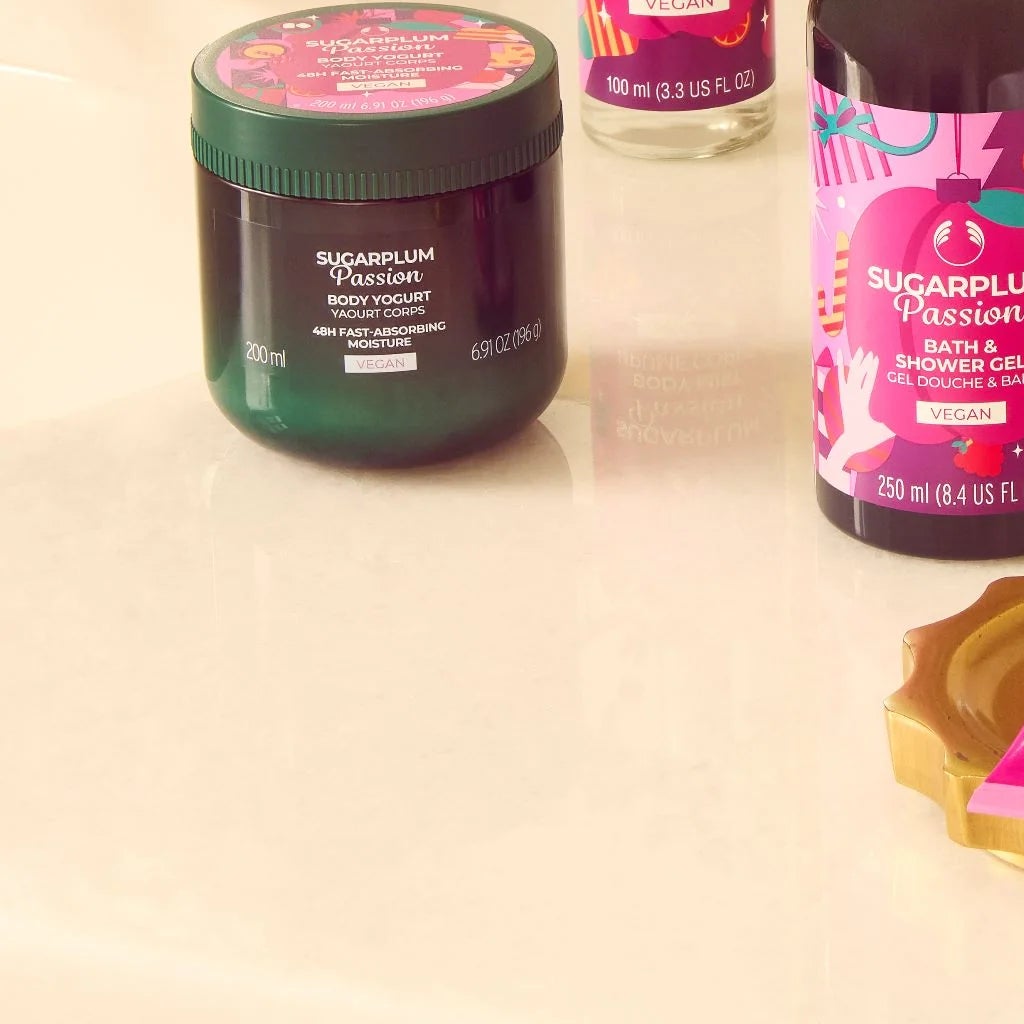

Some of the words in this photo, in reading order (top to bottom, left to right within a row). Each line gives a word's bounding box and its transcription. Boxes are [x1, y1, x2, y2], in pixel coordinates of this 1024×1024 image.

[306, 35, 449, 48] SUGARPLUM
[322, 42, 436, 54] Passion
[317, 56, 367, 64] BODY
[371, 52, 444, 60] YOGURT
[330, 65, 463, 76] FAST-ABSORBING
[342, 72, 420, 81] MOISTURE
[607, 76, 628, 95] 100
[634, 82, 650, 98] ml
[656, 82, 684, 102] (3.3
[690, 80, 710, 98] US
[716, 77, 730, 94] FL
[735, 69, 755, 88] OZ)
[310, 99, 336, 108] 200
[340, 102, 356, 110] ml
[361, 102, 385, 110] 6.91
[391, 100, 407, 108] OZ
[411, 98, 438, 108] (196
[441, 94, 455, 103] g)
[316, 247, 434, 266] SUGARPLUM
[330, 265, 424, 286] Passion
[328, 294, 369, 306] BODY
[372, 291, 431, 305] YOGURT
[331, 309, 381, 318] YAOURT
[384, 306, 425, 318] CORPS
[312, 326, 336, 336] 48H
[340, 322, 446, 337] FAST-ABSORBING
[348, 337, 412, 348] MOISTURE
[472, 339, 493, 360] 6.91
[496, 333, 510, 353] OZ
[513, 324, 531, 349] (196
[534, 318, 541, 341] g)
[924, 339, 978, 354] BATH
[984, 340, 997, 353] &
[246, 341, 268, 364] 200
[271, 350, 286, 367] ml
[356, 358, 404, 369] VEGAN
[896, 354, 986, 373] SHOWER
[888, 371, 914, 386] GEL
[917, 375, 984, 389] DOUCHE
[987, 377, 997, 388] &
[930, 407, 991, 420] VEGAN
[878, 474, 904, 500] 250
[911, 482, 928, 504] ml
[935, 483, 966, 507] (8.4
[973, 484, 994, 505] US
[1001, 482, 1018, 503] FL
